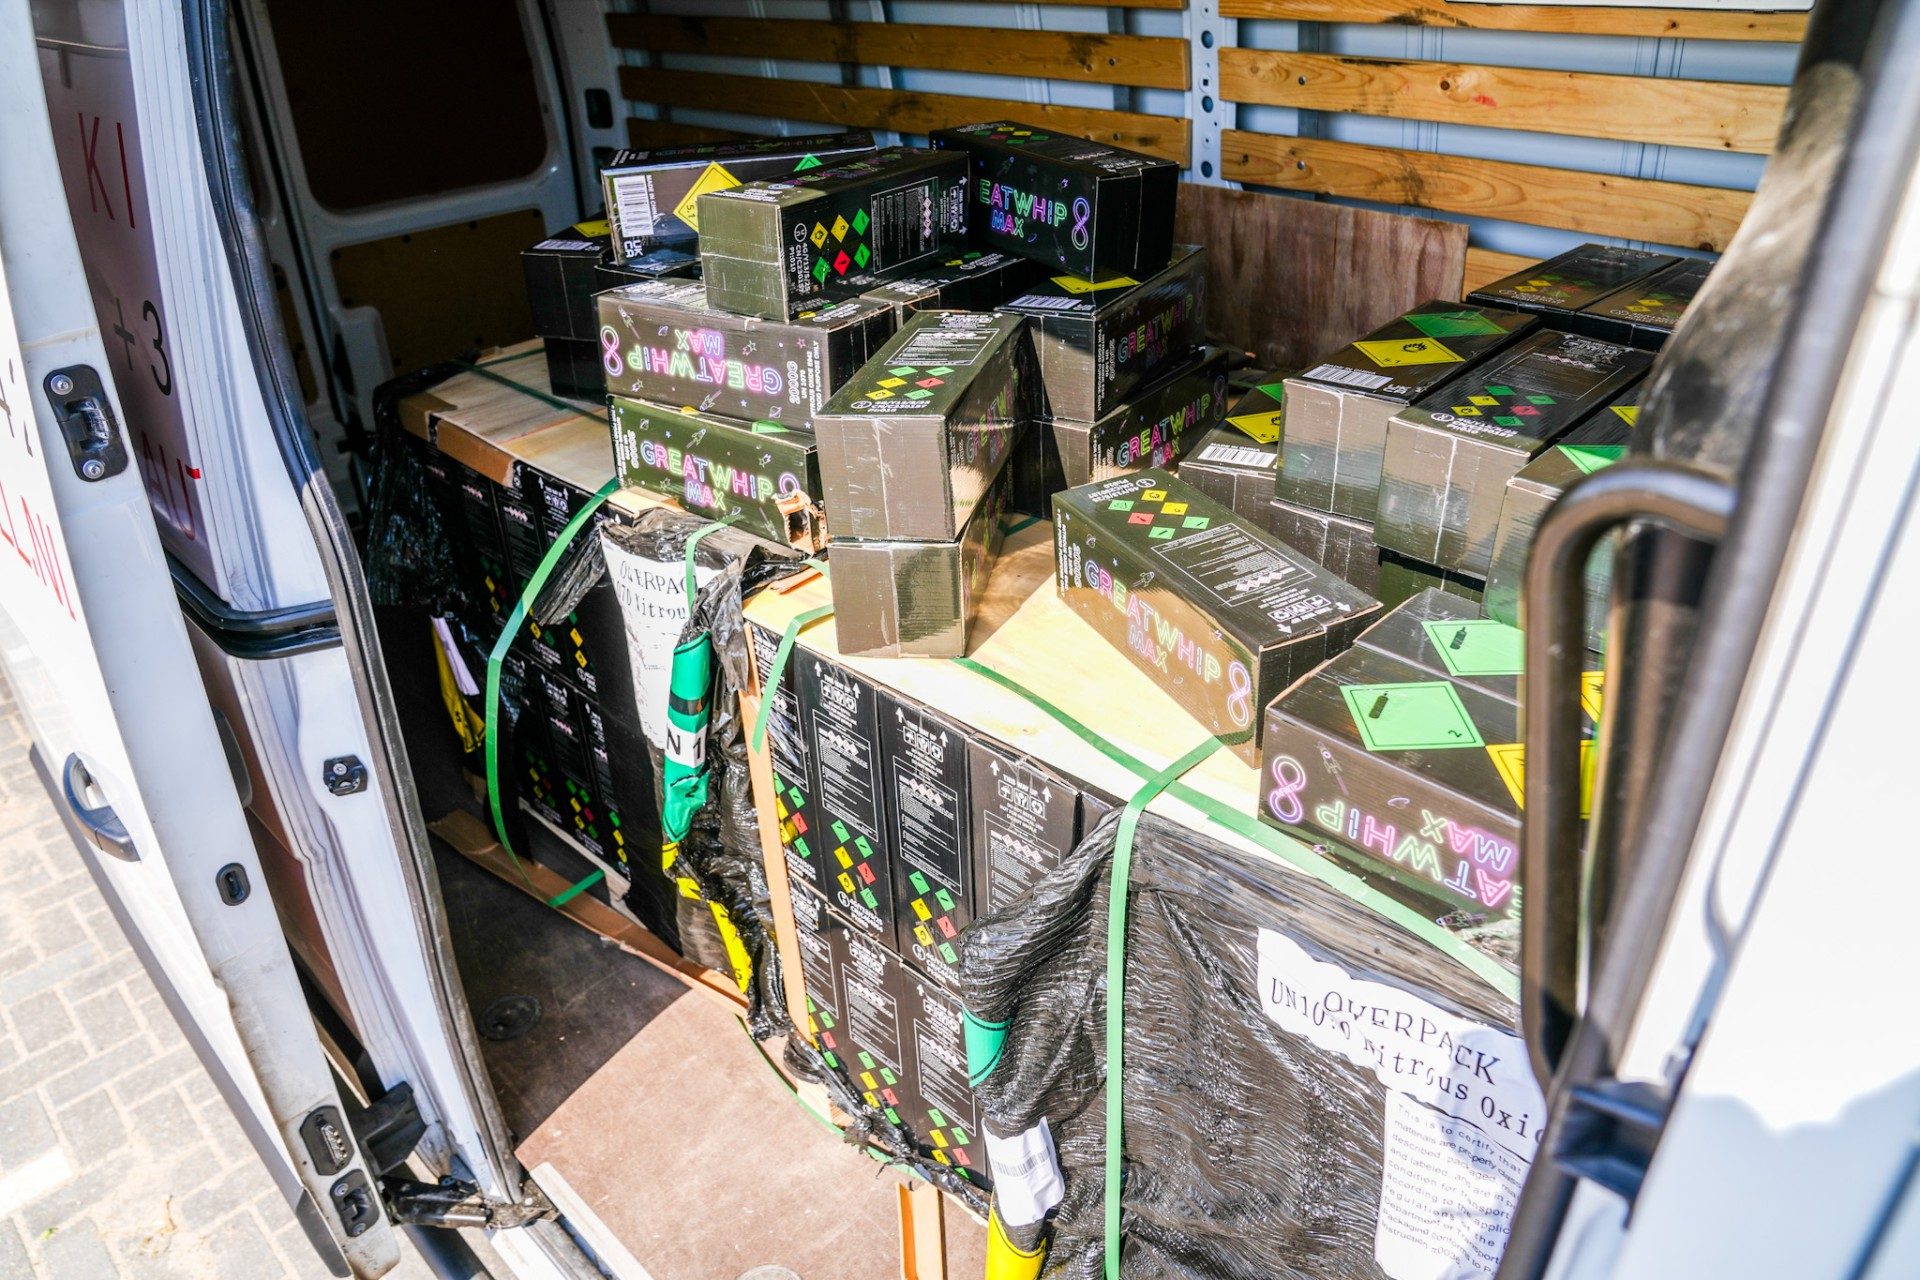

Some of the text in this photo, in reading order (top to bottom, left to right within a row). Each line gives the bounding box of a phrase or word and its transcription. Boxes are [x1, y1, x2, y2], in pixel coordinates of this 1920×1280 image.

[991, 209, 1025, 239] MAX
[674, 329, 721, 356] MAX
[1118, 294, 1194, 364] GREATWHIP
[627, 344, 783, 395] GREATWHIP
[1117, 393, 1211, 469] GREATWHIP
[1152, 437, 1180, 468] MAX
[640, 440, 774, 502] GREATWHIP
[686, 480, 726, 511] MAX
[1084, 560, 1221, 683] GREATWHIP
[1128, 624, 1168, 674] MAX
[666, 728, 701, 760] N 1
[684, 785, 698, 798] 2
[1420, 809, 1514, 871] MAX
[1392, 1133, 1440, 1159] described
[1394, 1119, 1436, 1144] materials
[1439, 1140, 1457, 1149] are
[1441, 1125, 1453, 1135] to
[1458, 1131, 1494, 1155] certify
[1498, 1155, 1521, 1174] that
[1388, 1160, 1437, 1186] condition
[1441, 1183, 1457, 1193] for
[1390, 1147, 1408, 1161] and
[1473, 1187, 1491, 1197] are
[1385, 1184, 1455, 1221] regulations
[1475, 1233, 1495, 1247] the
[1386, 1172, 1438, 1203] according
[1443, 1198, 1454, 1206] to
[1473, 1219, 1511, 1235] applic
[1472, 1259, 1481, 1269] to
